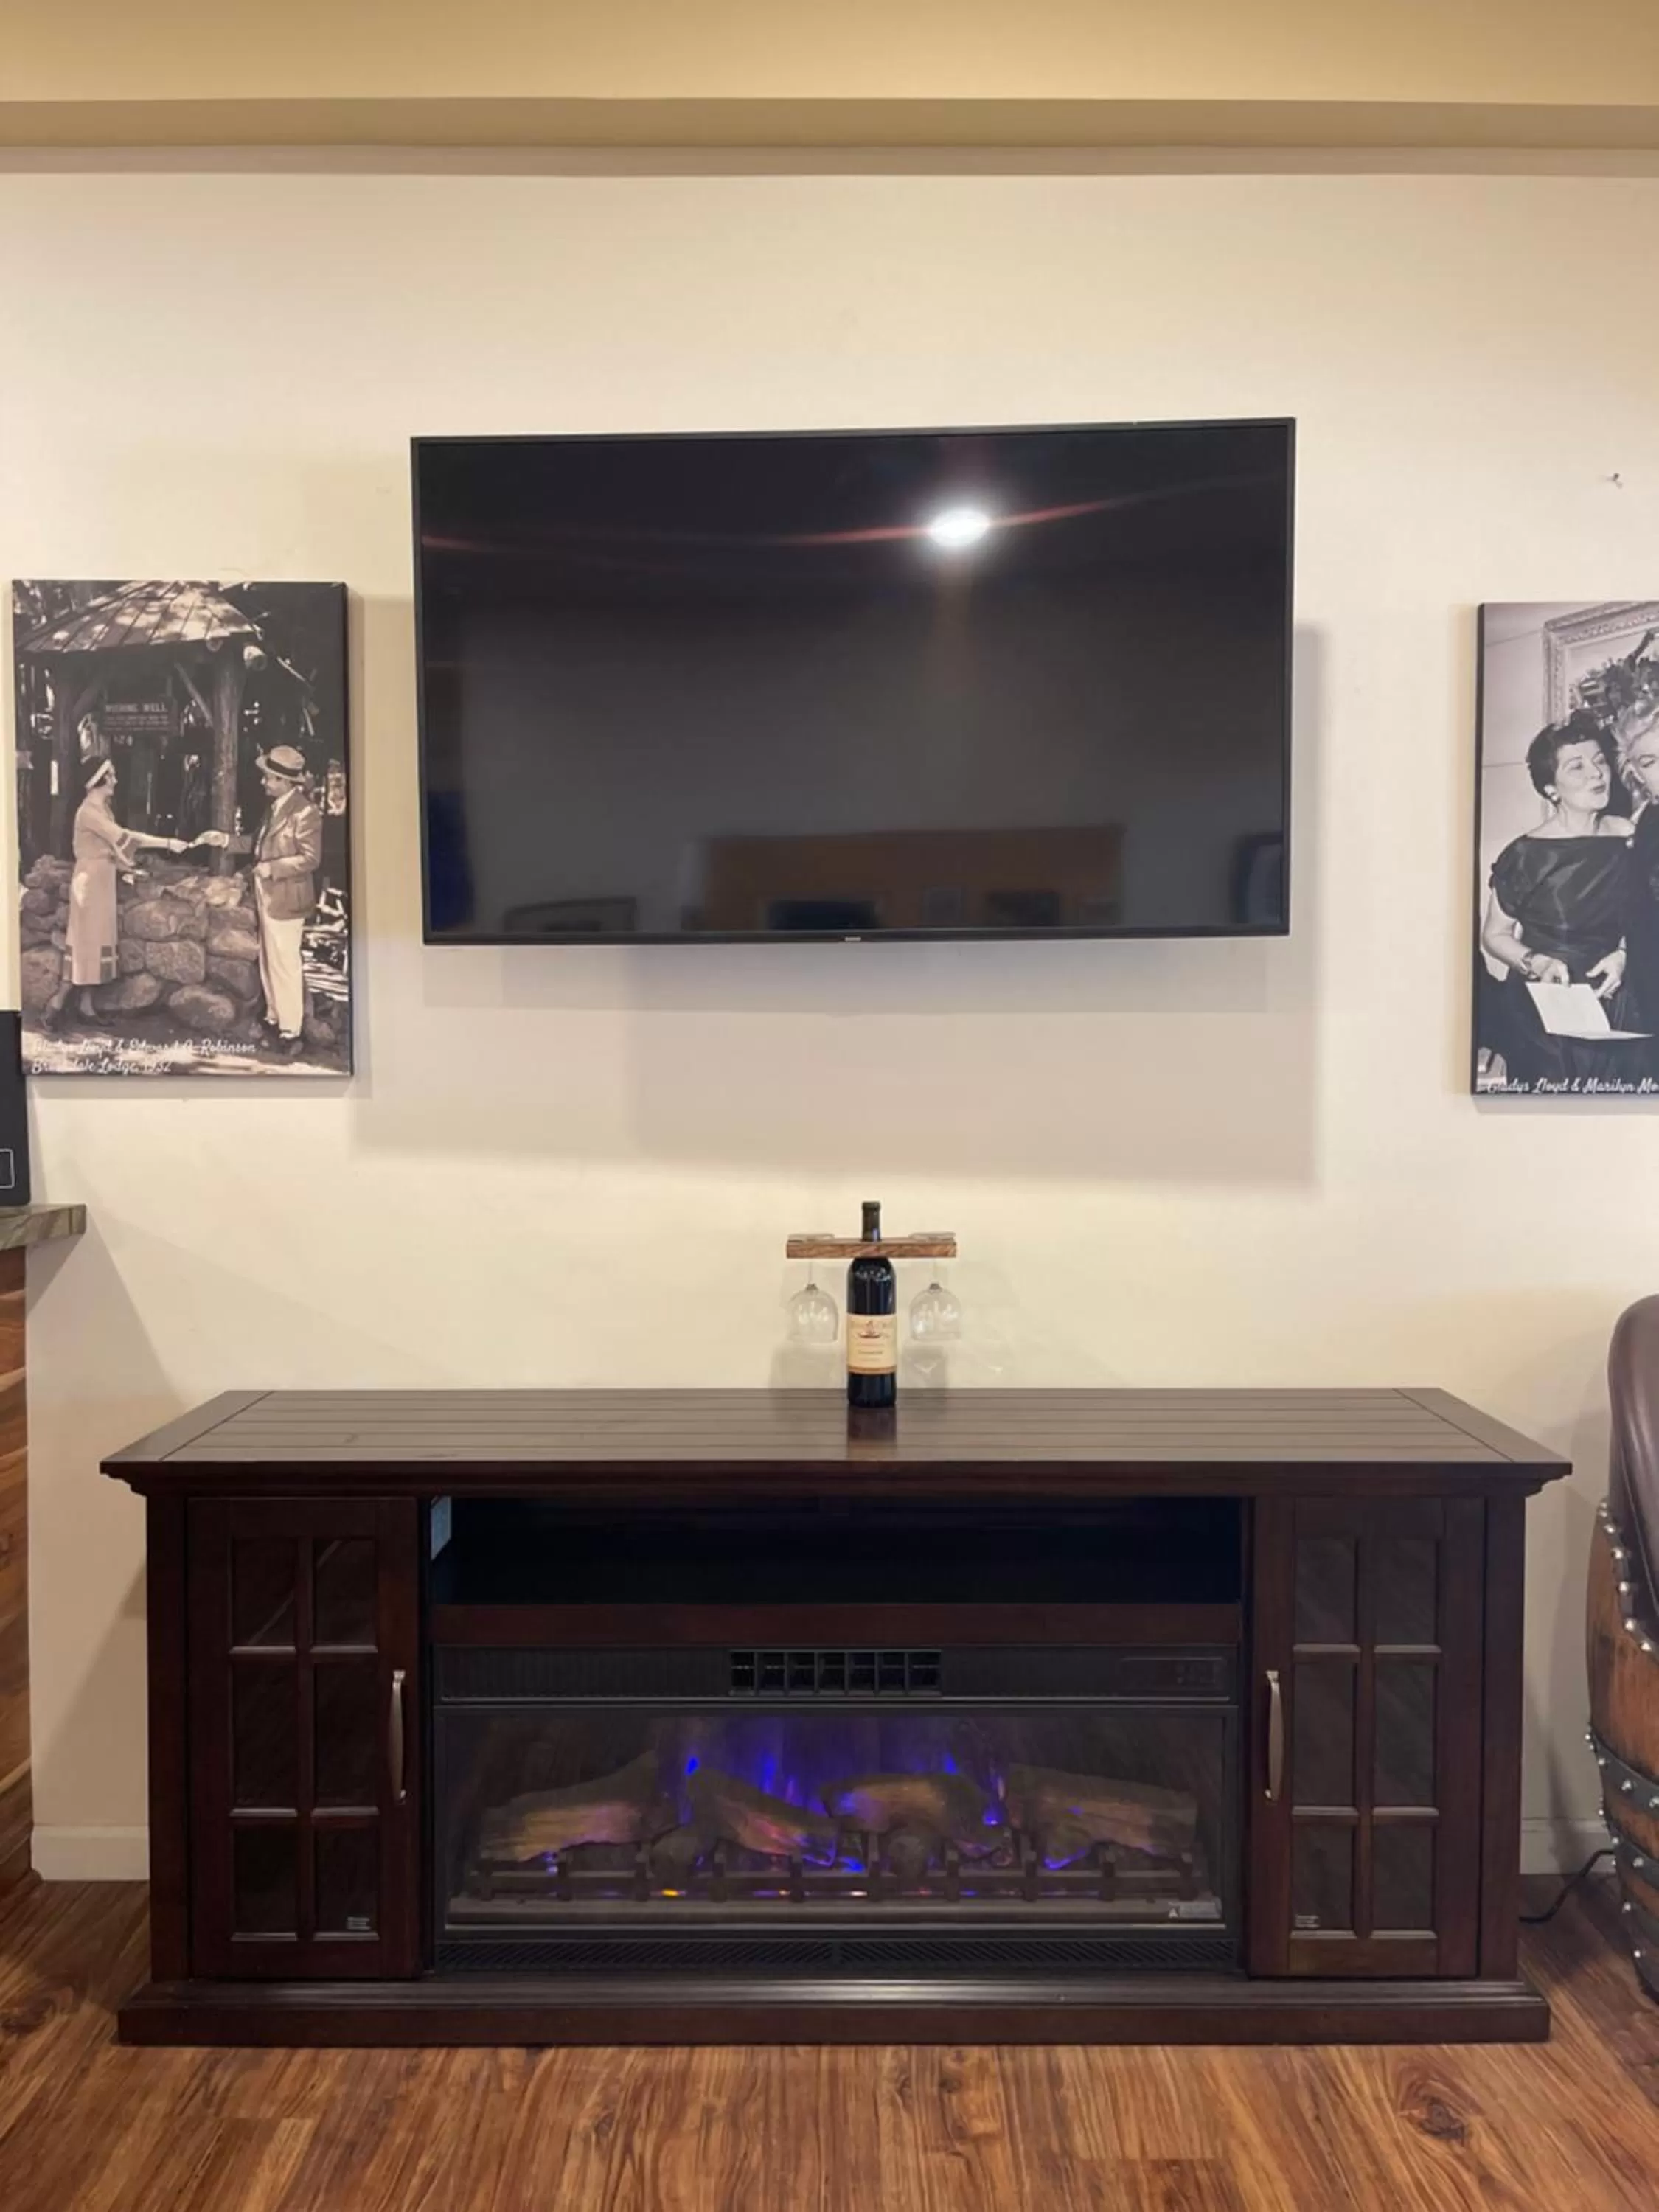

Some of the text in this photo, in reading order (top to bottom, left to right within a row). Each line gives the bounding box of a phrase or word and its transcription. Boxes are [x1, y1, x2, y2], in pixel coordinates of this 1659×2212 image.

[200, 1038, 257, 1056] Robinson
[1531, 1077, 1569, 1094] Lloyd
[1571, 1077, 1582, 1092] &
[1582, 1077, 1635, 1094] Marilyn
